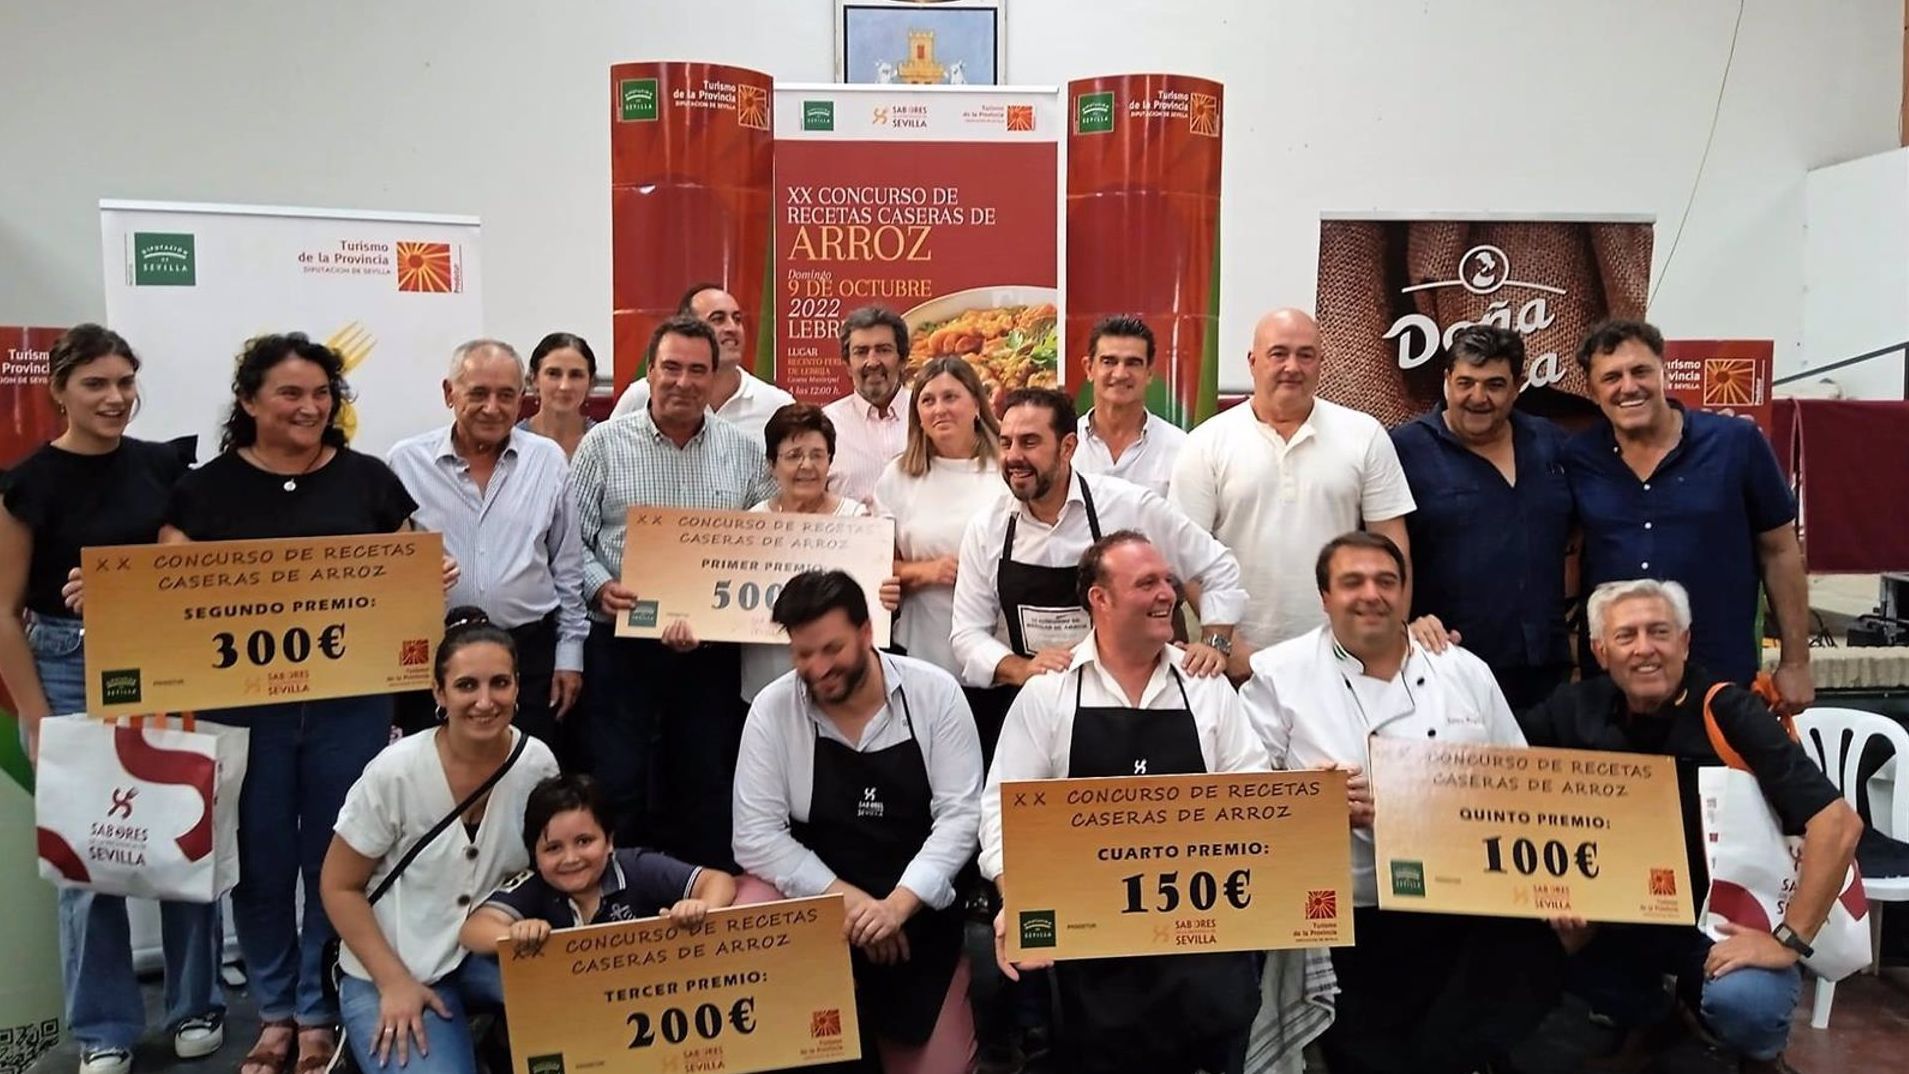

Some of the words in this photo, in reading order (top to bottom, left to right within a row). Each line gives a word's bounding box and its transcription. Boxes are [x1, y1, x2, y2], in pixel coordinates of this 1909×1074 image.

[704, 80, 736, 92] Turismo
[1158, 90, 1189, 100] Turismo
[674, 89, 684, 98] de
[687, 90, 696, 99] la
[699, 91, 736, 102] Provincia
[1130, 100, 1140, 110] de
[1154, 100, 1189, 111] Provincia
[892, 119, 928, 128] SEVILLA
[788, 187, 812, 204] XX
[818, 187, 926, 205] CONCURSO
[933, 188, 958, 204] DE
[788, 207, 872, 224] RECETAS
[878, 207, 964, 224] CASERAS
[971, 208, 996, 225] DE
[340, 240, 388, 252] Turismo
[788, 226, 932, 261] ARROZ
[144, 264, 188, 272] SEVILLA
[298, 253, 313, 263] de
[318, 253, 329, 263] la
[335, 254, 389, 265] Provincia
[788, 269, 832, 283] Domingo
[788, 280, 800, 297] 9
[807, 280, 832, 297] DE
[839, 279, 932, 298] OCTUBRE
[788, 299, 841, 318] 2022
[8, 348, 50, 360] Turism
[788, 348, 818, 356] LUGAR
[2, 362, 50, 374] Provinci
[1668, 370, 1700, 380] vincia
[678, 516, 766, 530] CONCURSO
[774, 518, 794, 532] DE
[680, 532, 754, 546] CASERAS
[762, 535, 784, 547] DE
[790, 538, 848, 550] ARROZ
[153, 550, 274, 570] CONCURSO
[285, 547, 314, 562] DE
[324, 543, 417, 560] RECETAS
[701, 558, 760, 571] PRIMER
[158, 572, 260, 590] CASERAS
[272, 569, 300, 584] DE
[310, 564, 387, 581] ARROZ
[184, 602, 284, 620] SEGUNDO
[292, 596, 376, 614] PREMIO:
[212, 623, 347, 669] 300€
[268, 684, 310, 696] SEVILLA
[1428, 751, 1528, 770] CONCURSO
[1537, 758, 1562, 773] DE
[1572, 761, 1652, 780] RECETAS
[1067, 786, 1180, 806] CONCURSO
[1191, 785, 1219, 799] DE
[1231, 782, 1320, 798] RECETAS
[1433, 772, 1518, 790] CASERAS
[1528, 780, 1553, 793] DE
[1562, 782, 1629, 798] ARROZ
[1071, 809, 1168, 828] CASERAS
[1178, 808, 1206, 822] DE
[1216, 805, 1292, 820] ARROZ
[1460, 808, 1530, 824] QUINTO
[1538, 813, 1611, 830] PREMIO:
[91, 822, 148, 842] SABORES
[90, 846, 146, 866] SEVILLA
[1098, 845, 1179, 862] CUARTO
[1187, 842, 1270, 858] PREMIO:
[1482, 836, 1600, 880] 100€
[1120, 869, 1252, 914] 150€
[1535, 900, 1572, 910] SEVILLA
[565, 925, 678, 954] CONCURSO
[728, 908, 818, 932] RECETAS
[1176, 919, 1216, 929] SABORES
[1176, 935, 1216, 946] SEVILLA
[571, 950, 668, 976] CASERAS
[679, 944, 706, 960] DE
[715, 933, 792, 957] ARROZ
[604, 983, 678, 1003] TERCER
[686, 972, 768, 993] PREMIO:
[626, 997, 758, 1050] 200€
[684, 1060, 725, 1074] SEVILLA
